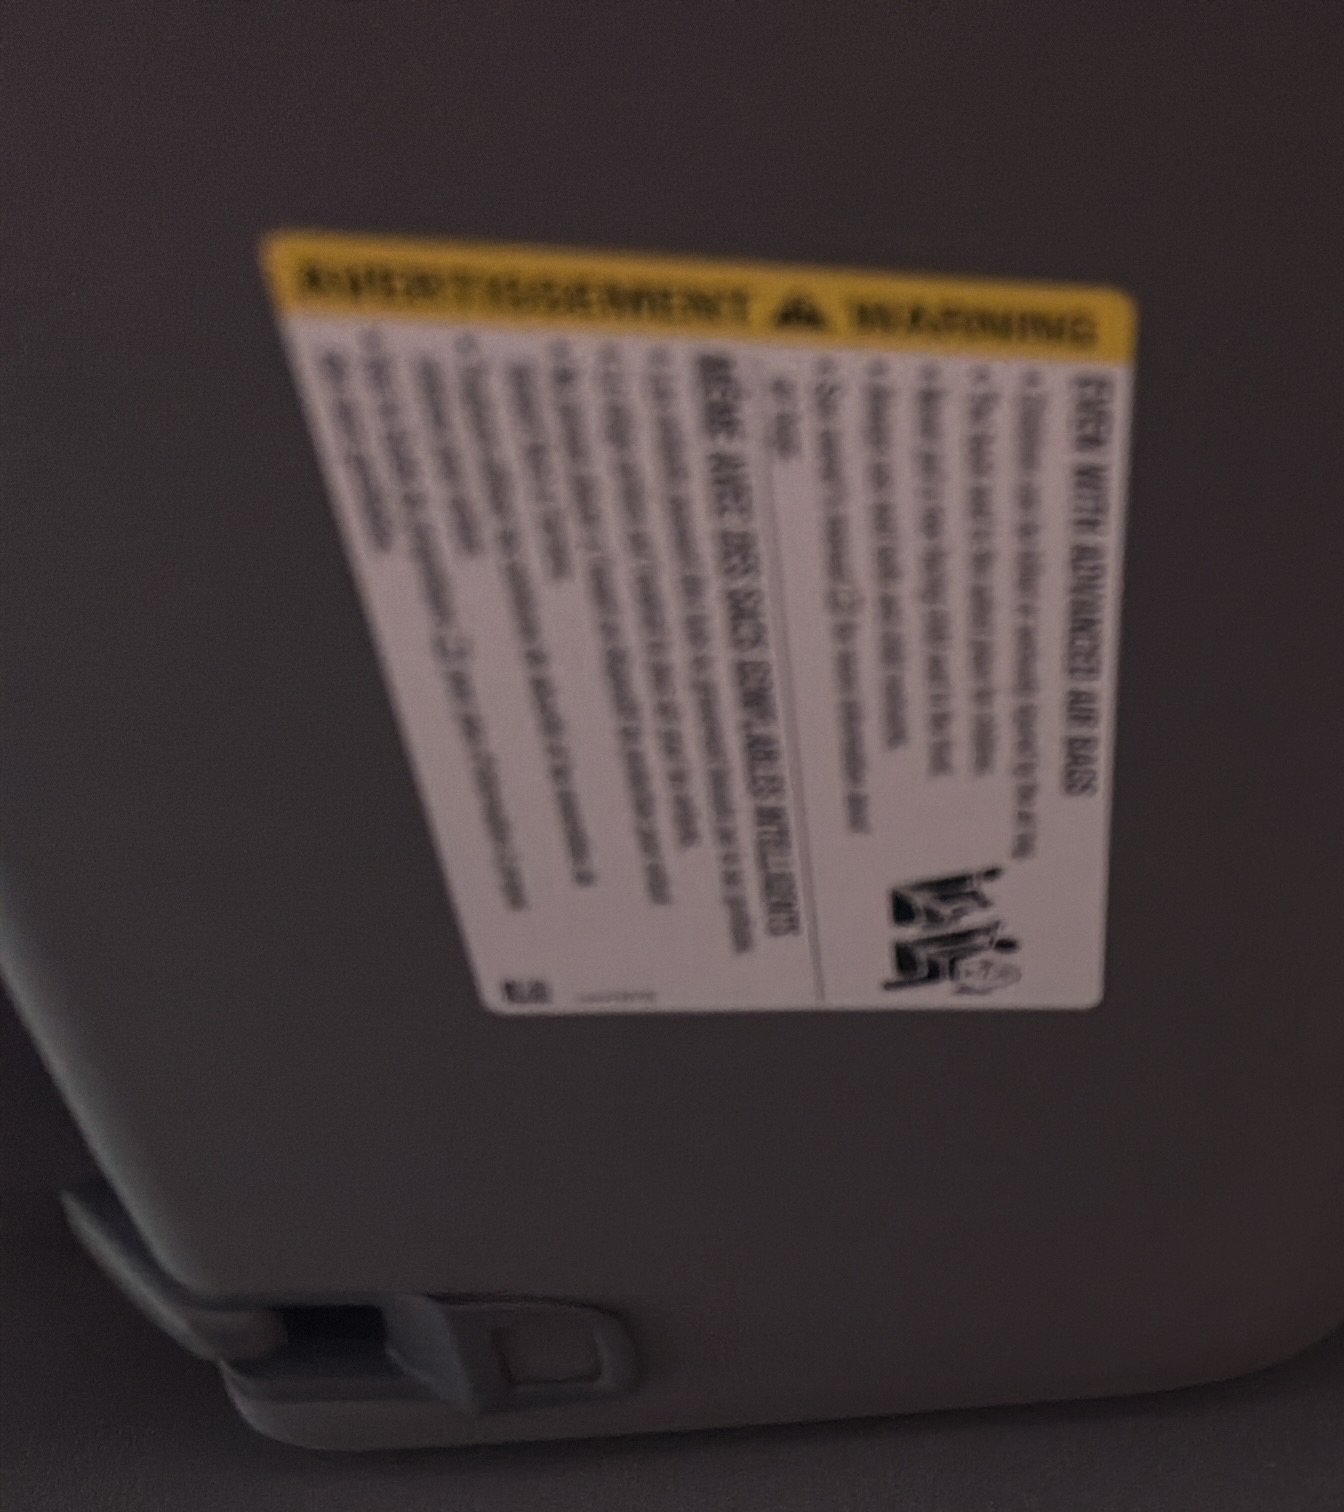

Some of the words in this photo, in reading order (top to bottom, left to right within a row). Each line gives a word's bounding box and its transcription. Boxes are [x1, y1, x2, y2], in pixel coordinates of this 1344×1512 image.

[848, 297, 1099, 348] WARNING
[1072, 372, 1115, 450] EVEN
[1070, 461, 1109, 537] WITH
[1061, 734, 1098, 797] BAGS
